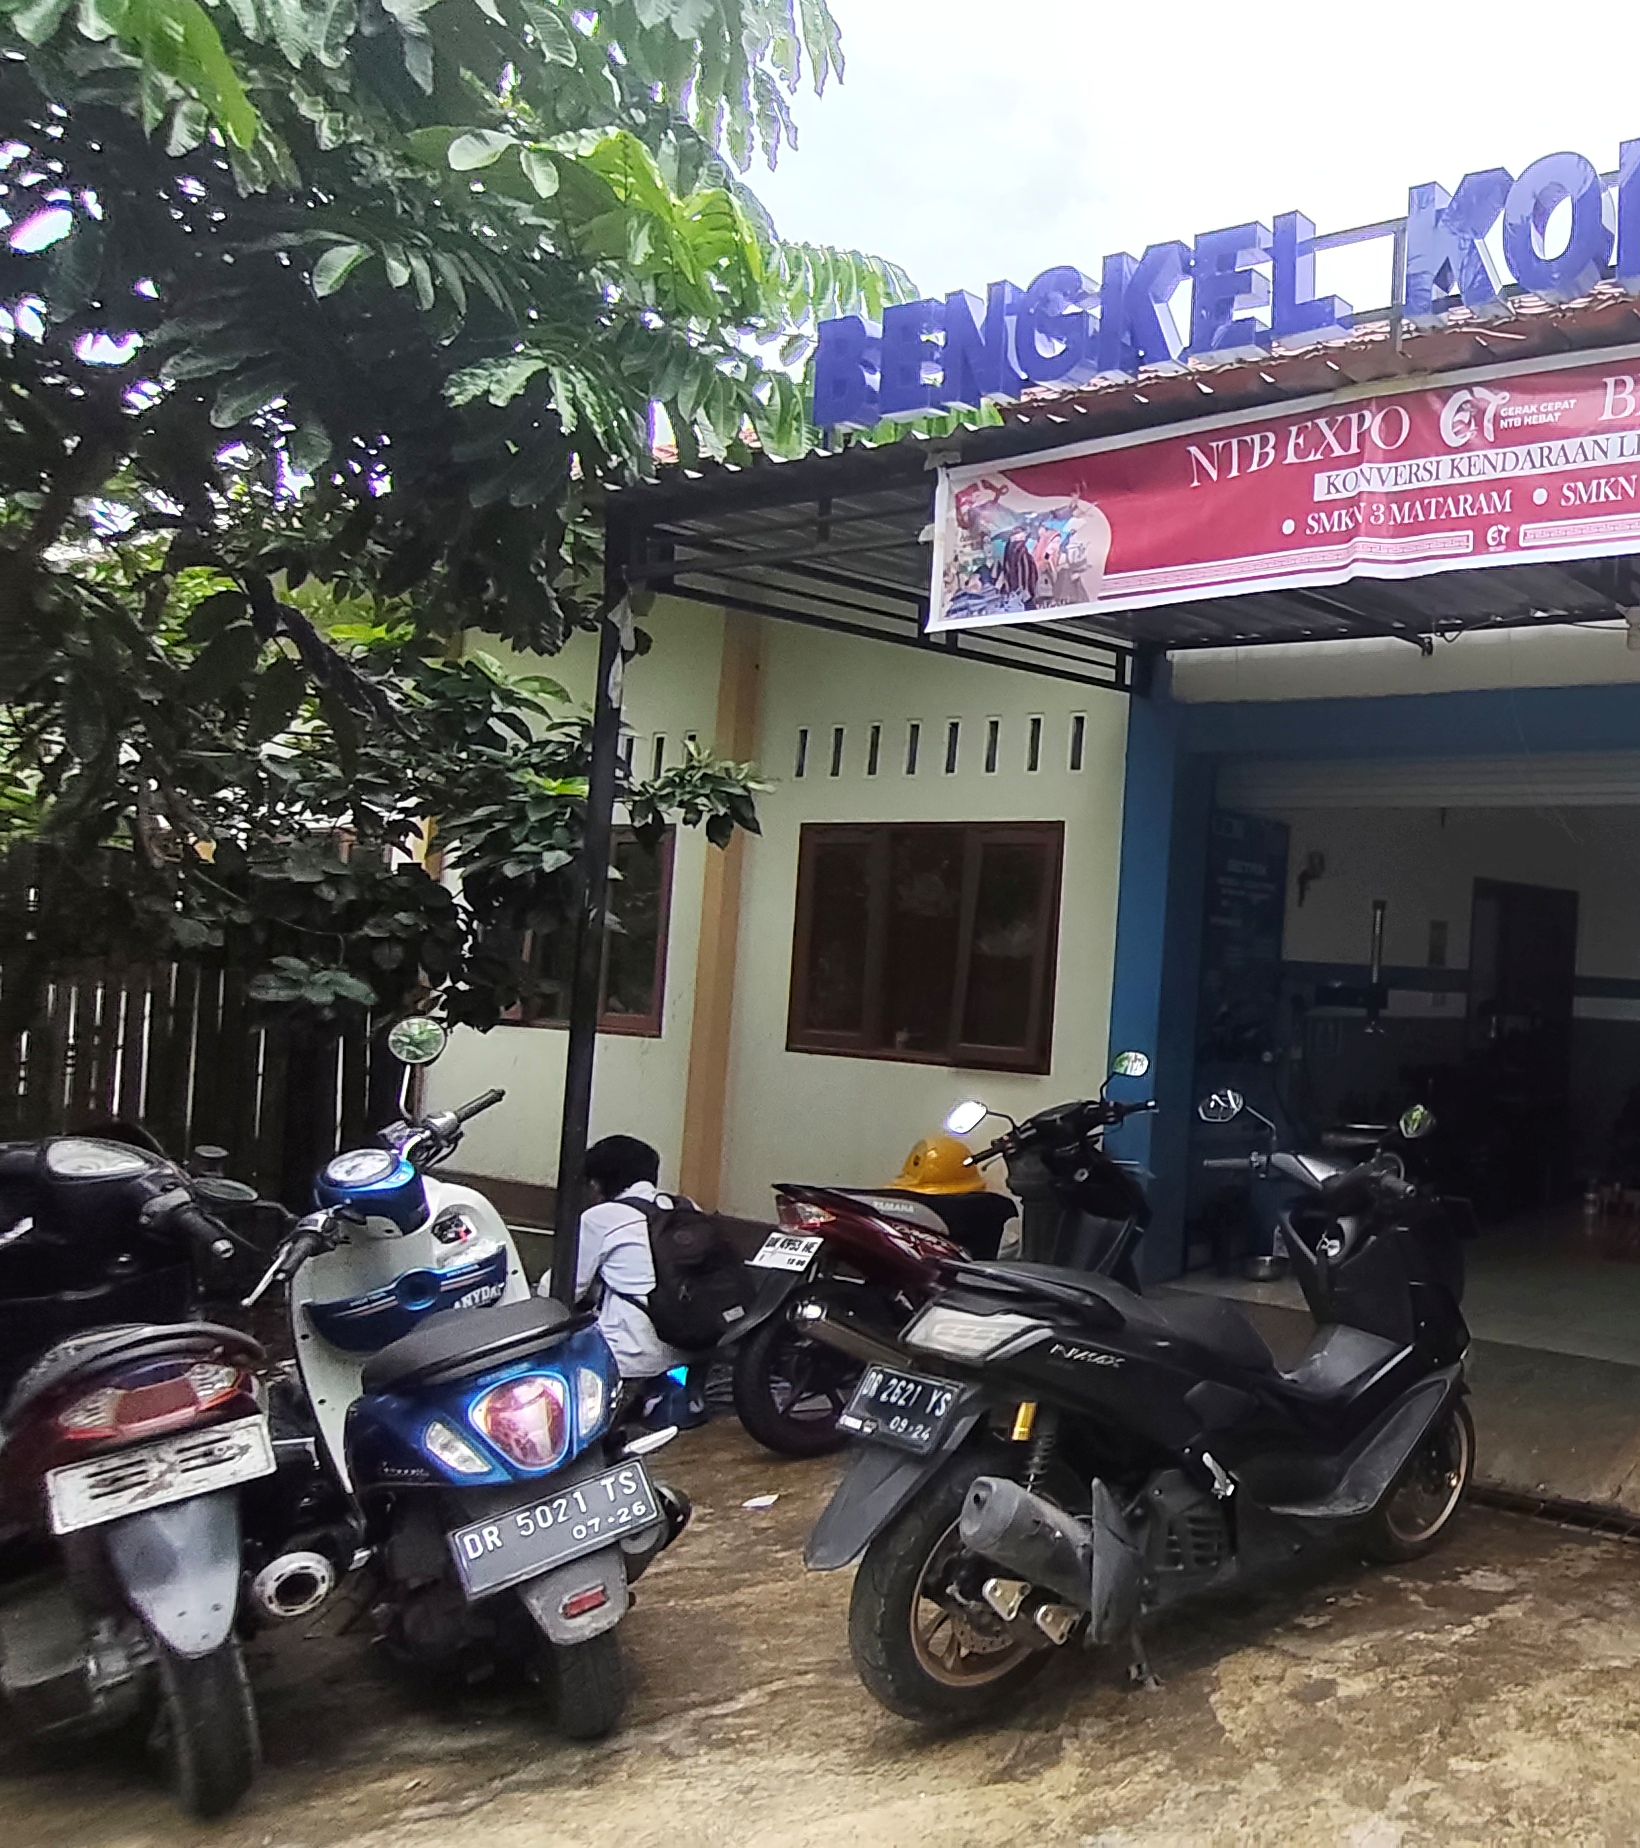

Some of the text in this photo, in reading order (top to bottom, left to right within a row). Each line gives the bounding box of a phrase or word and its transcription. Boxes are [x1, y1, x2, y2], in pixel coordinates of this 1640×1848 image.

[812, 210, 1348, 427] BENGKEL
[1500, 399, 1577, 418] GERAK CEPAT
[1500, 412, 1562, 430] NTB HEBAT
[1187, 405, 1411, 488] NTB EXPO
[1325, 462, 1442, 497] KONVERSI
[1448, 440, 1610, 480] KENDARAAN
[1305, 488, 1513, 536] SMKN 3 MATARAM
[1560, 474, 1638, 508] SMKN
[872, 1201, 914, 1213] YAMAHA
[880, 1378, 922, 1407] 2621
[925, 1388, 952, 1417] YS
[463, 1470, 637, 1560] DR 5021 TS
